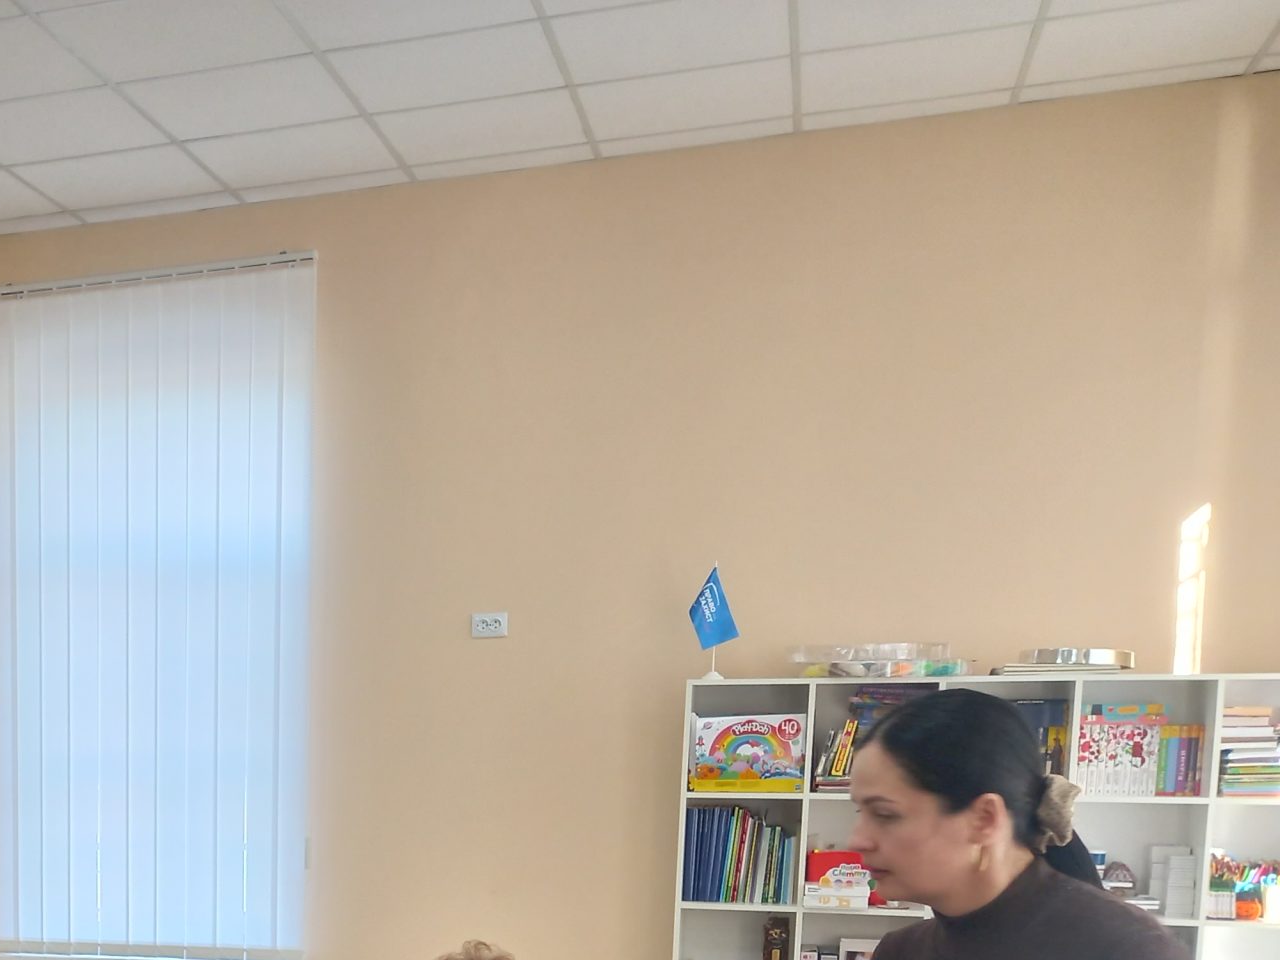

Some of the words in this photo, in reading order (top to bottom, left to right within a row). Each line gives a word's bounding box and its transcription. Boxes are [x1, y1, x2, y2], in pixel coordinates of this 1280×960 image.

[703, 588, 717, 613] ПРАВО
[781, 720, 797, 735] 40
[832, 868, 867, 878] Clemmy
